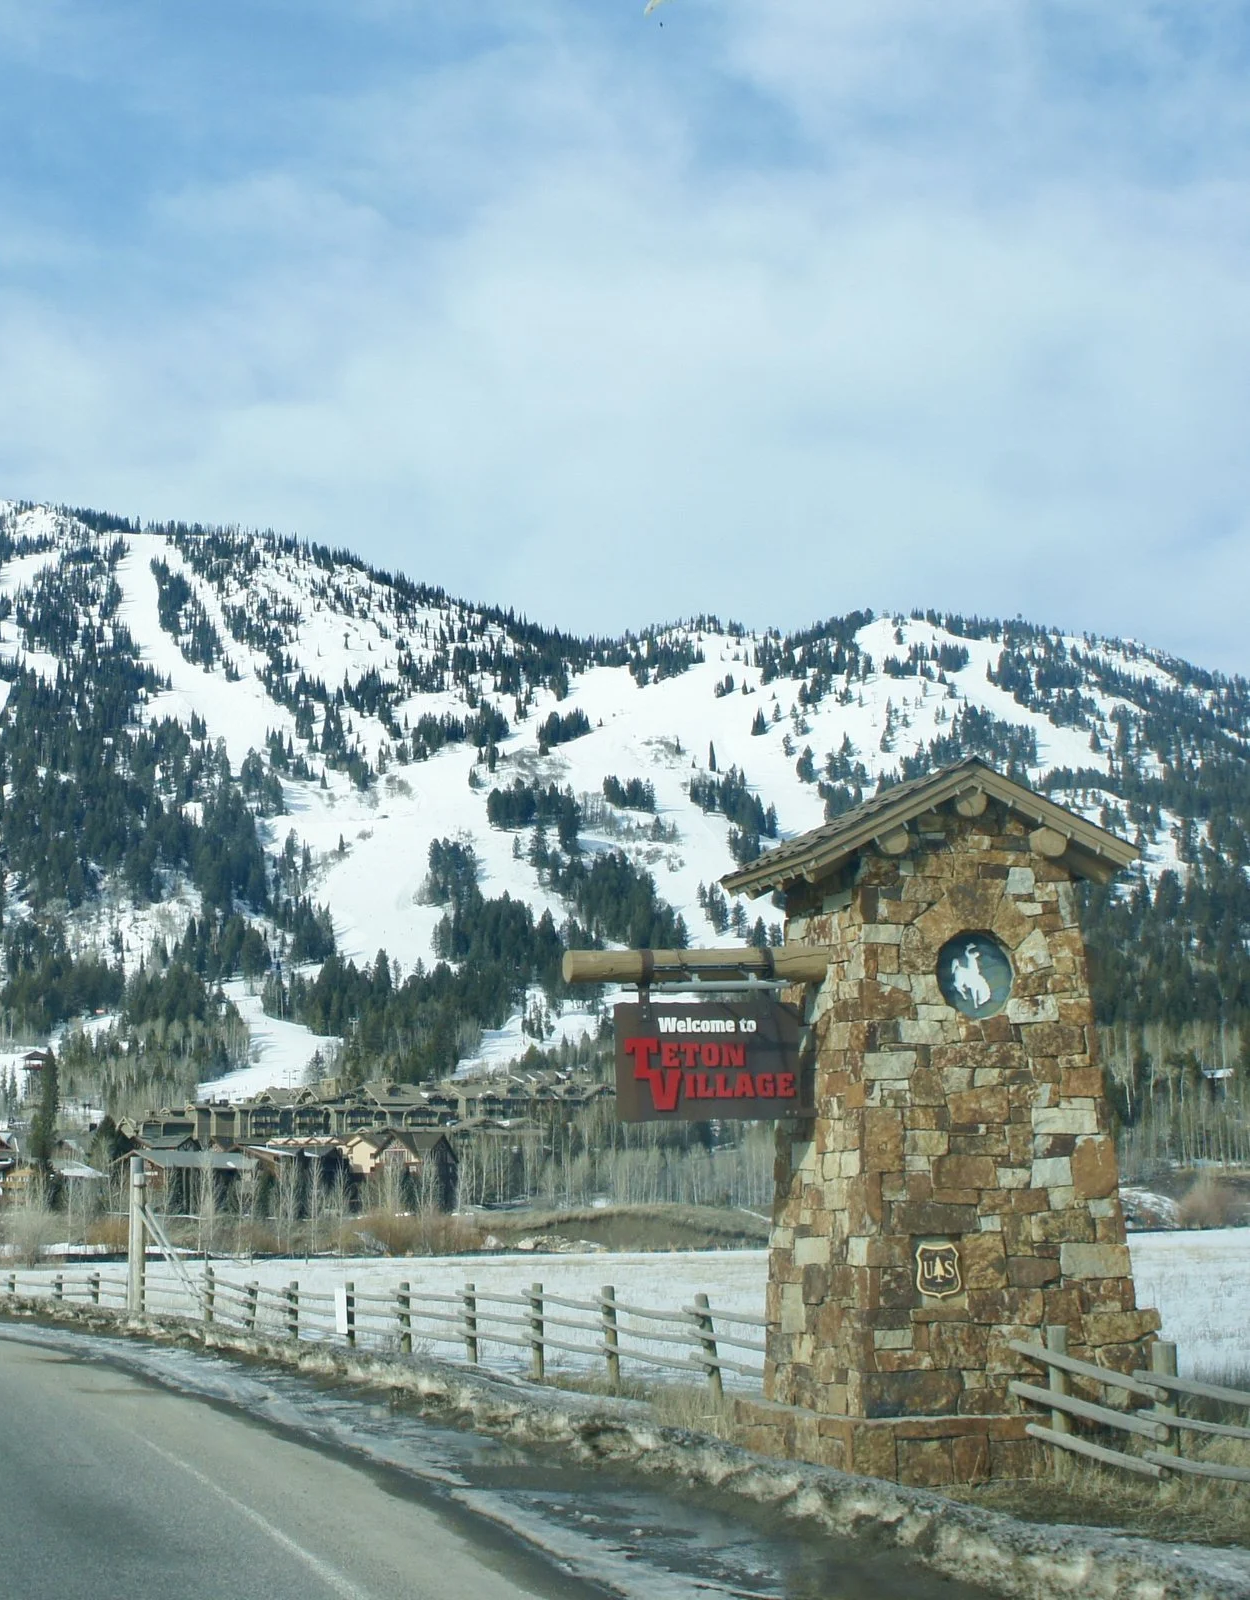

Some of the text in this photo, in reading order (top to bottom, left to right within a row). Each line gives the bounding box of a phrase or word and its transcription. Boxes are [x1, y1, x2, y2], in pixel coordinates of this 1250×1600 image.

[658, 1017, 757, 1033] Welcome to
[624, 1037, 746, 1081] TETON
[649, 1068, 797, 1112] VILLAGE
